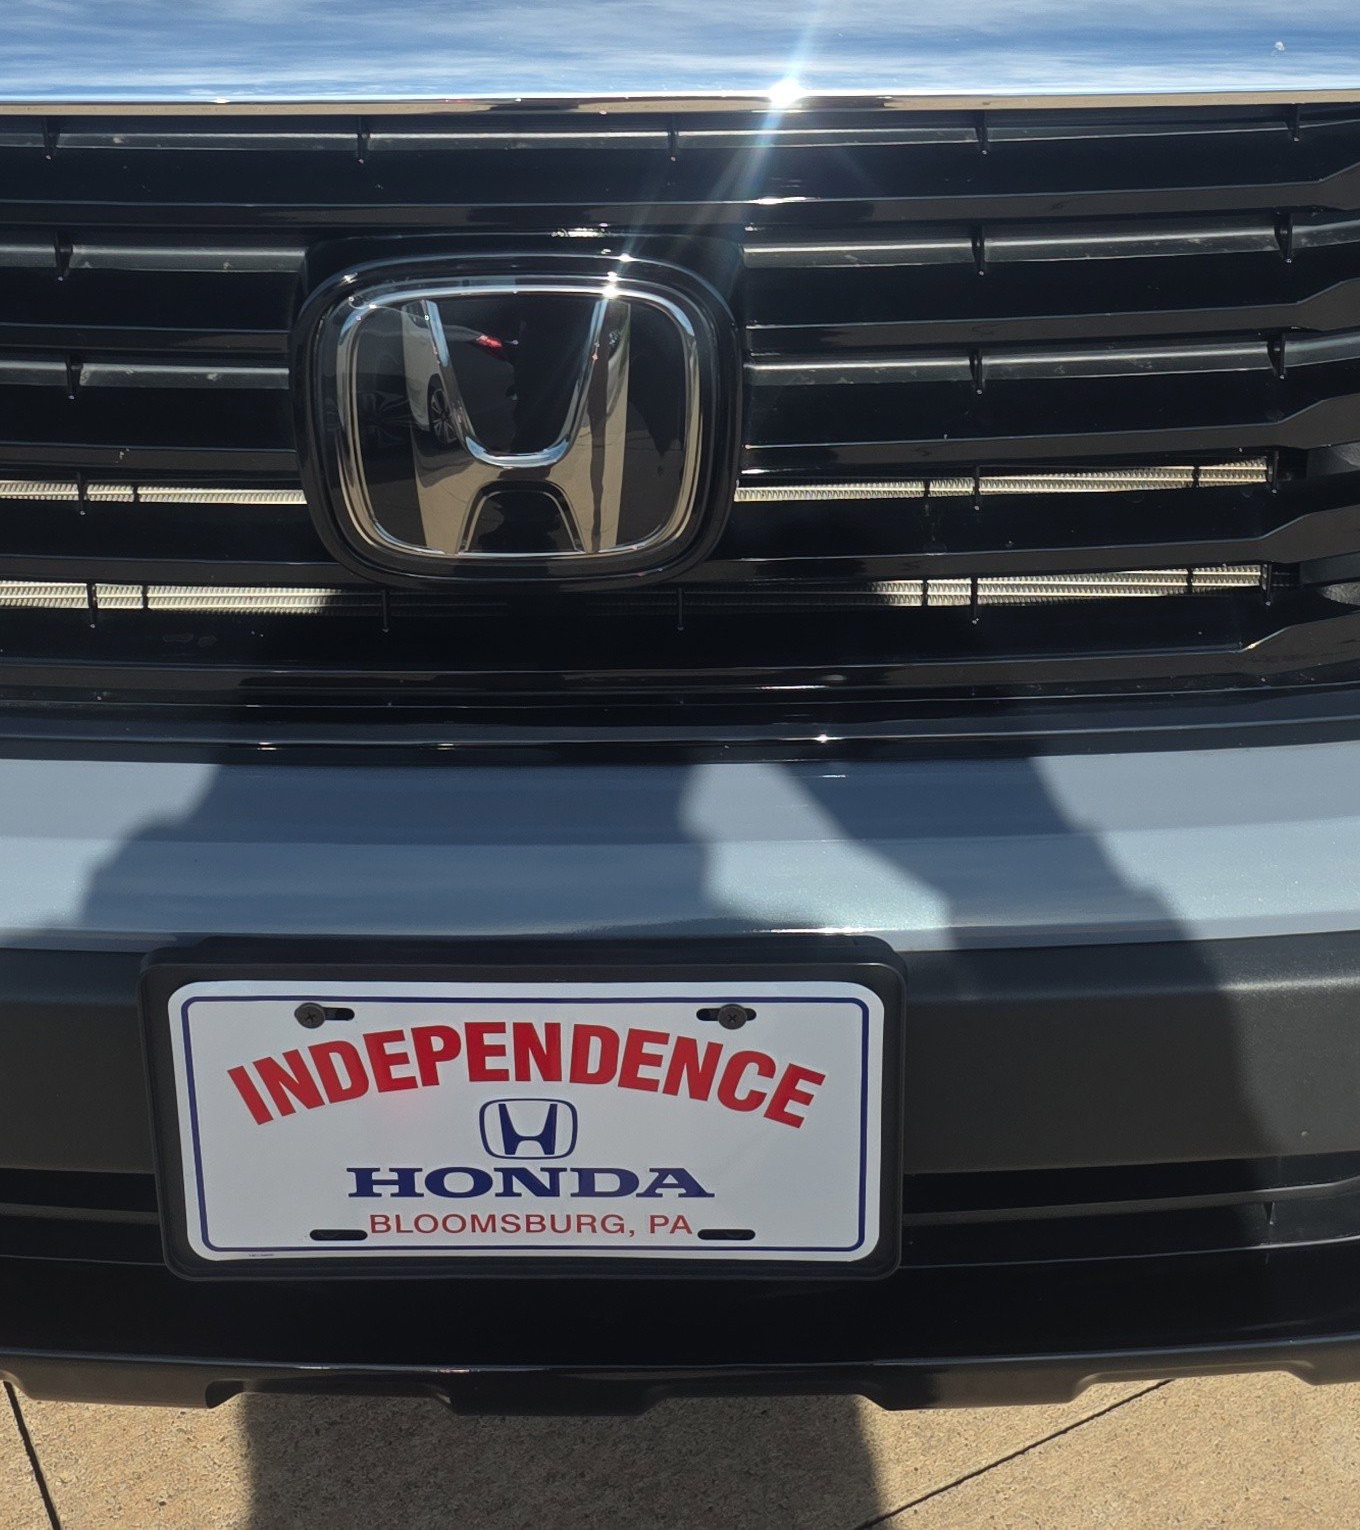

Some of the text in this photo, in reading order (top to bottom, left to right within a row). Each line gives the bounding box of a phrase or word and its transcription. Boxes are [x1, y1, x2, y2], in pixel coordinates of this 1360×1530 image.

[226, 1021, 827, 1129] INDEPENDENCE
[346, 1166, 715, 1199] HONDA
[369, 1213, 694, 1238] BLOOMSBURG, PA
